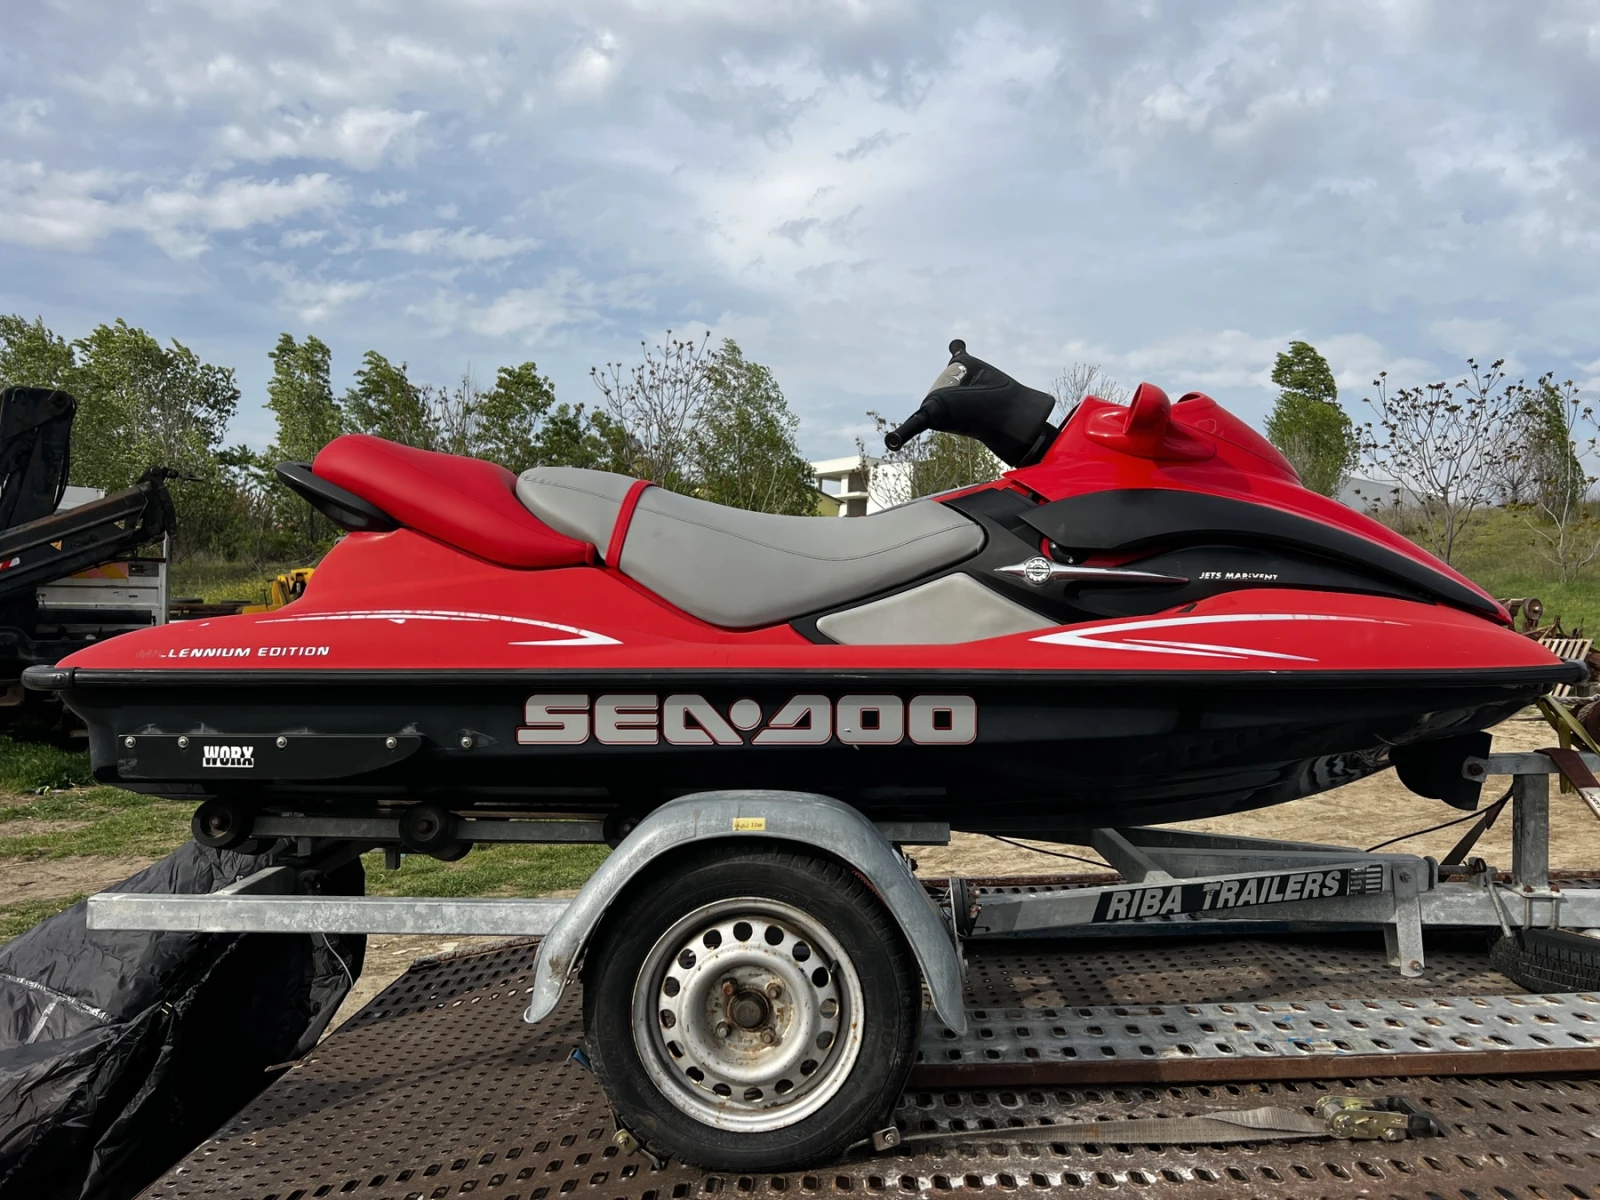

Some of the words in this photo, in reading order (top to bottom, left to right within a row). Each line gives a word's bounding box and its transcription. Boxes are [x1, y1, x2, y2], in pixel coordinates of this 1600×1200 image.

[1199, 571, 1222, 580] JETS
[257, 646, 330, 657] EDITION
[203, 745, 254, 768] WORX
[1106, 886, 1182, 921] RIBA
[1202, 871, 1341, 911] TRAILERS
